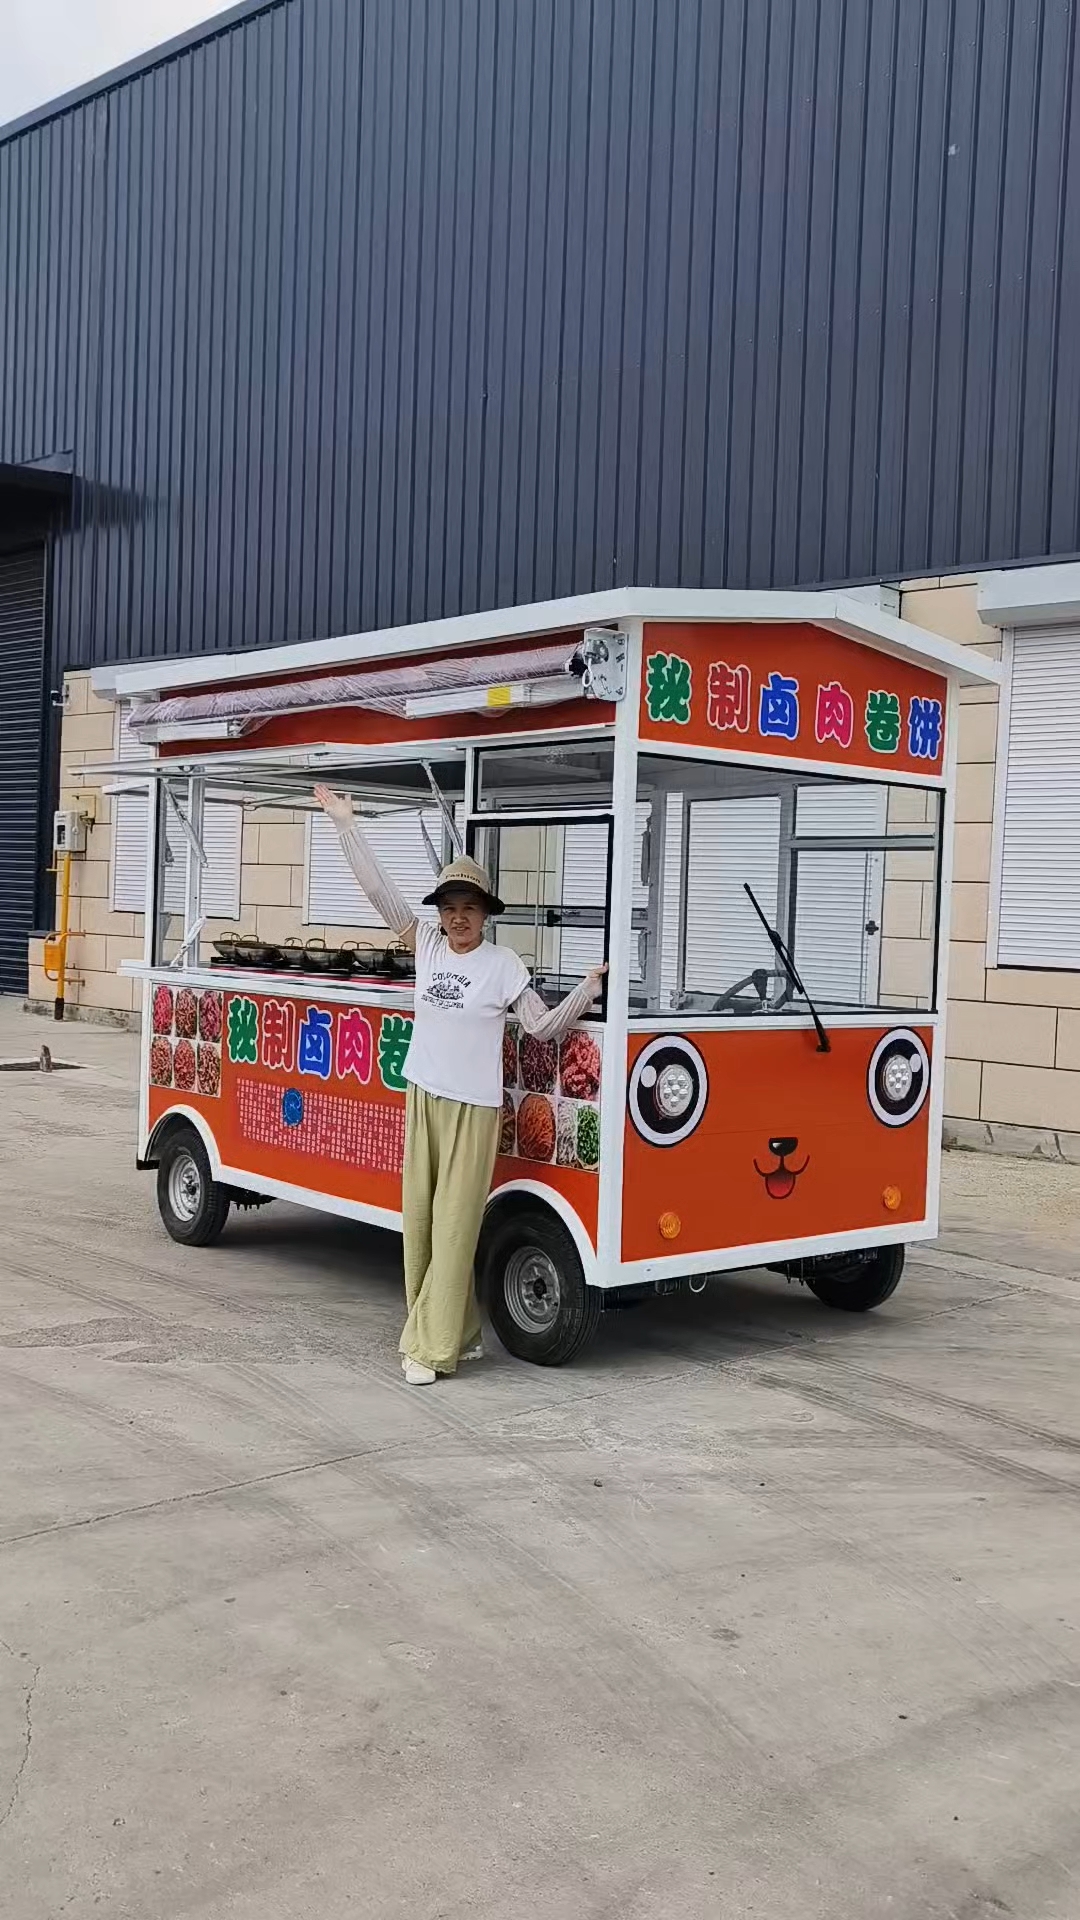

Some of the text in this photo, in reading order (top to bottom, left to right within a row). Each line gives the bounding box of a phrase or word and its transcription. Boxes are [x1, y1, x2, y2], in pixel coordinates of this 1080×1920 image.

[646, 651, 942, 760] 秘制卤肉卷饼
